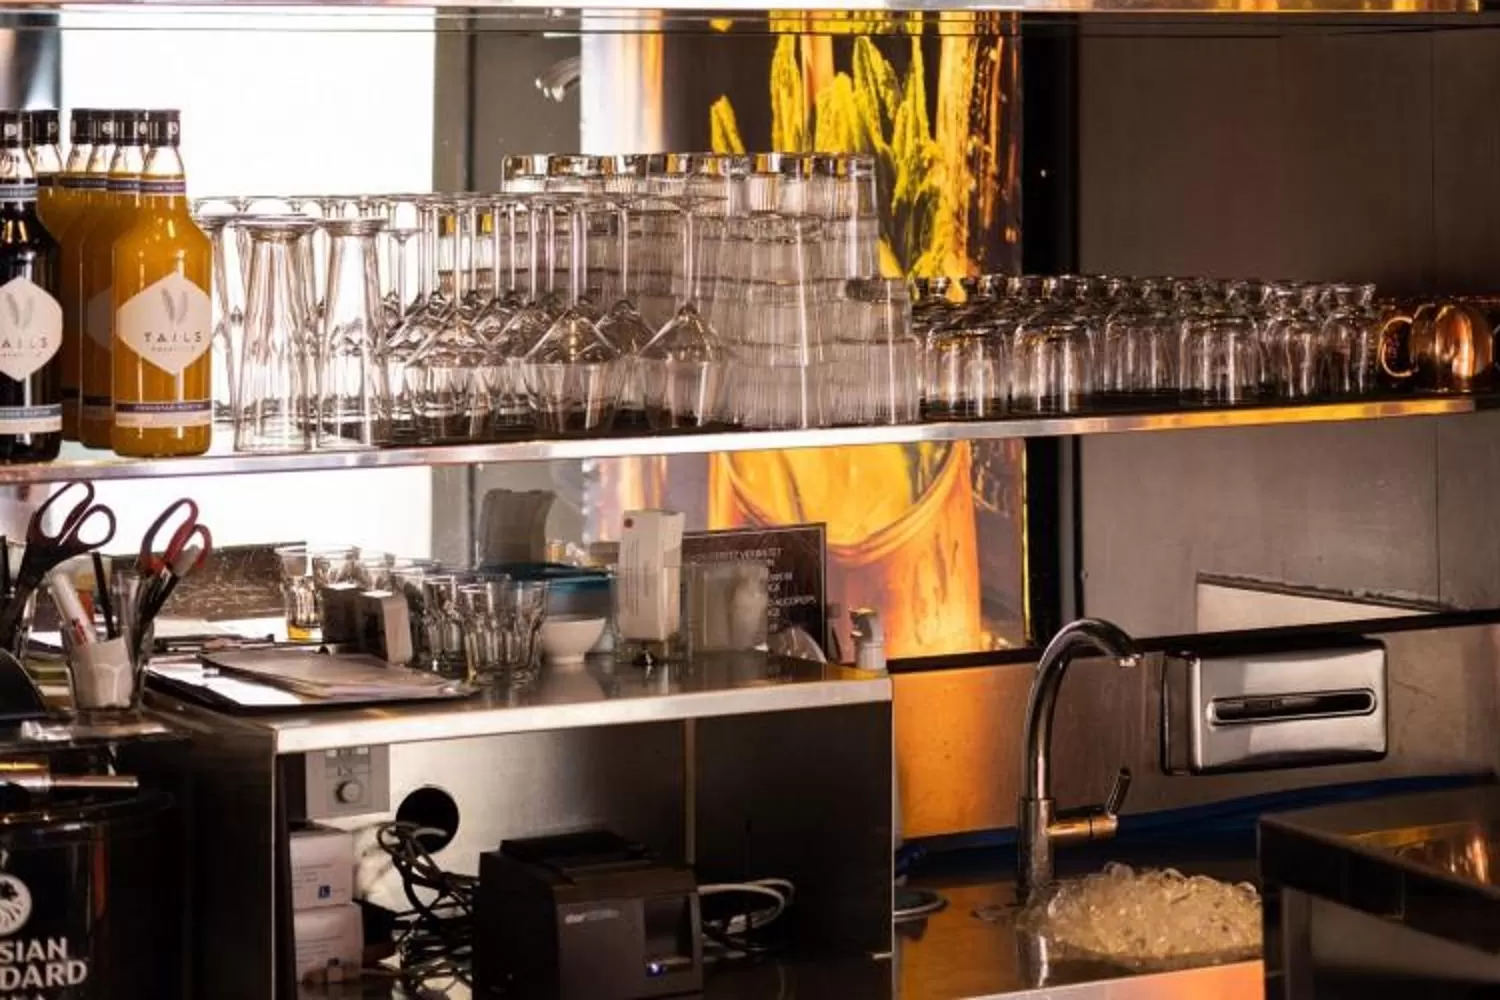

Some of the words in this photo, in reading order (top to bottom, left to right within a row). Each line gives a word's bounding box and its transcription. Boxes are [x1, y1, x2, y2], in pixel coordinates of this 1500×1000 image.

[1, 336, 48, 350] AILS
[144, 331, 202, 344] TAILS
[0, 936, 68, 964] SIAN
[0, 959, 89, 991] DARD
